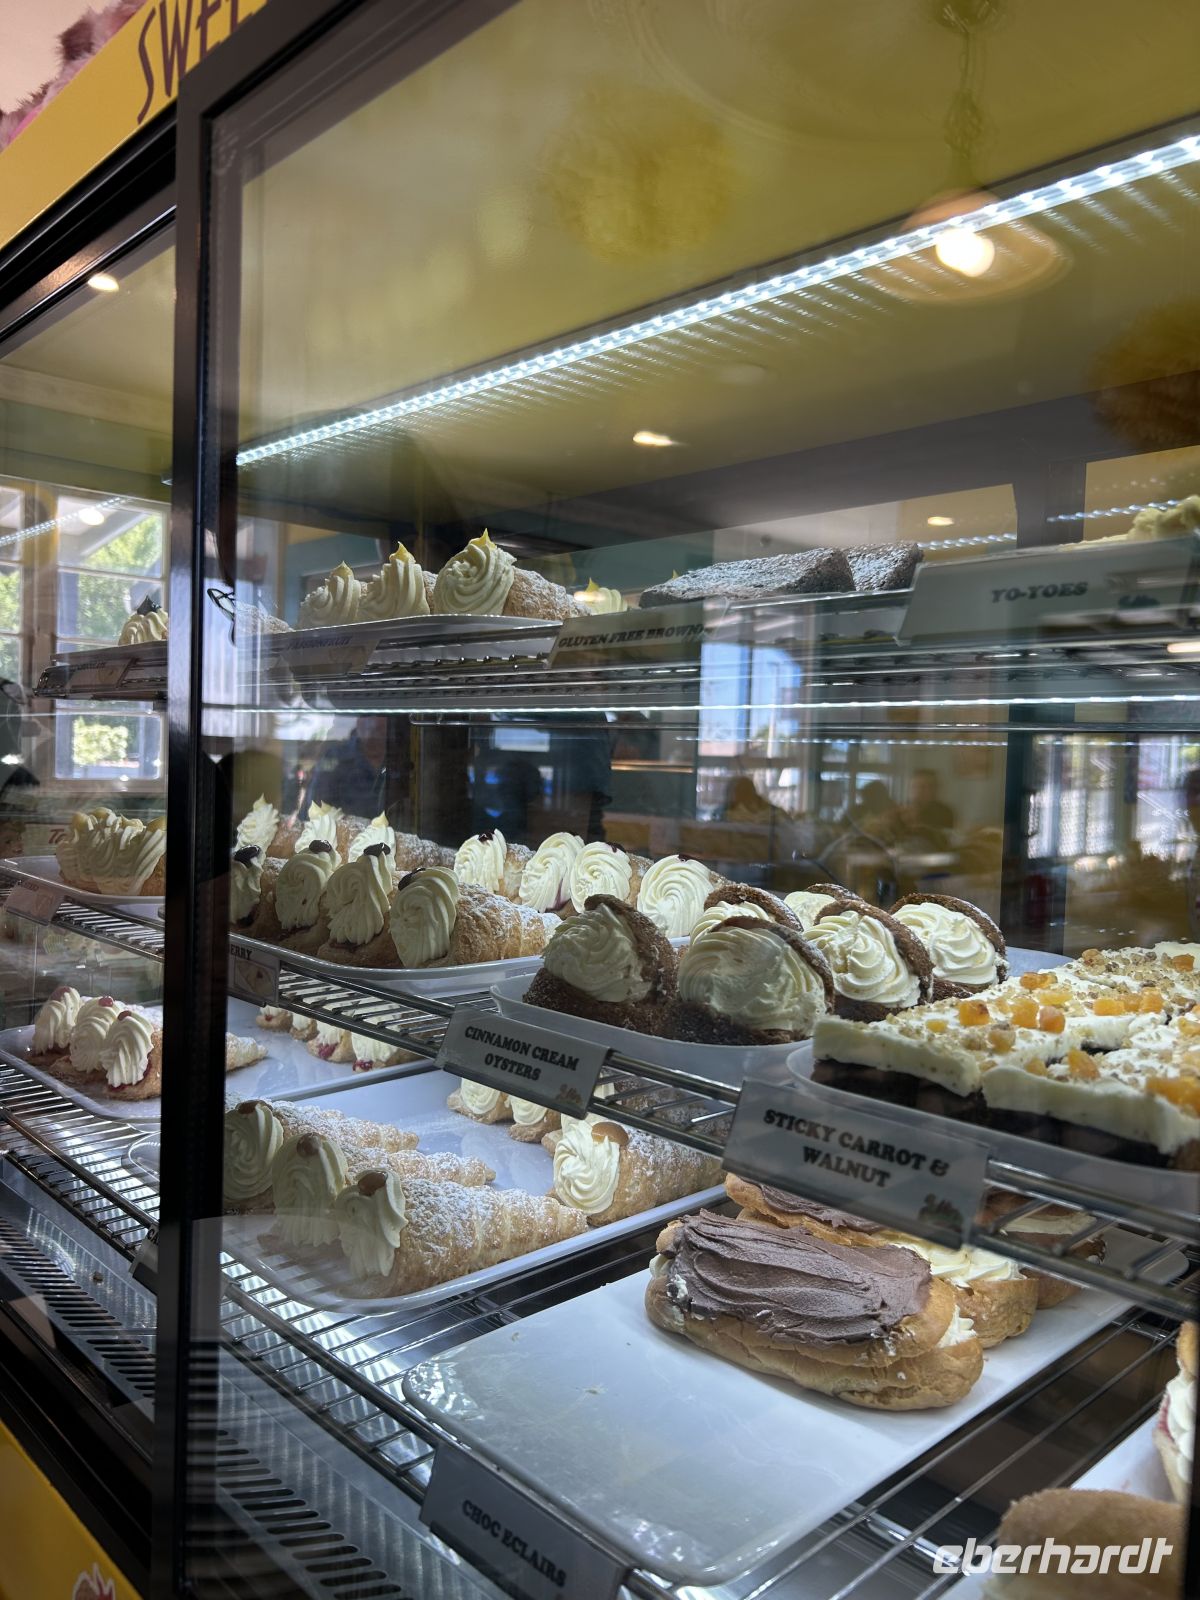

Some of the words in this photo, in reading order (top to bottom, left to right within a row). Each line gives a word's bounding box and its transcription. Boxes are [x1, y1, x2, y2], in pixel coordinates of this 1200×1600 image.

[991, 581, 1088, 603] YO-YOES
[558, 631, 607, 649] GLUTEN
[607, 629, 644, 646] FREE
[464, 1025, 532, 1058] CINNAMON
[532, 1046, 580, 1071] CREAM
[484, 1052, 542, 1081] OYSTERS
[763, 1108, 837, 1143] STICKY
[838, 1130, 926, 1171] CARROT
[929, 1158, 949, 1177] &
[803, 1145, 891, 1188] WALNUT
[462, 1499, 502, 1539] CHOC
[502, 1527, 567, 1588] ECLAIRS
